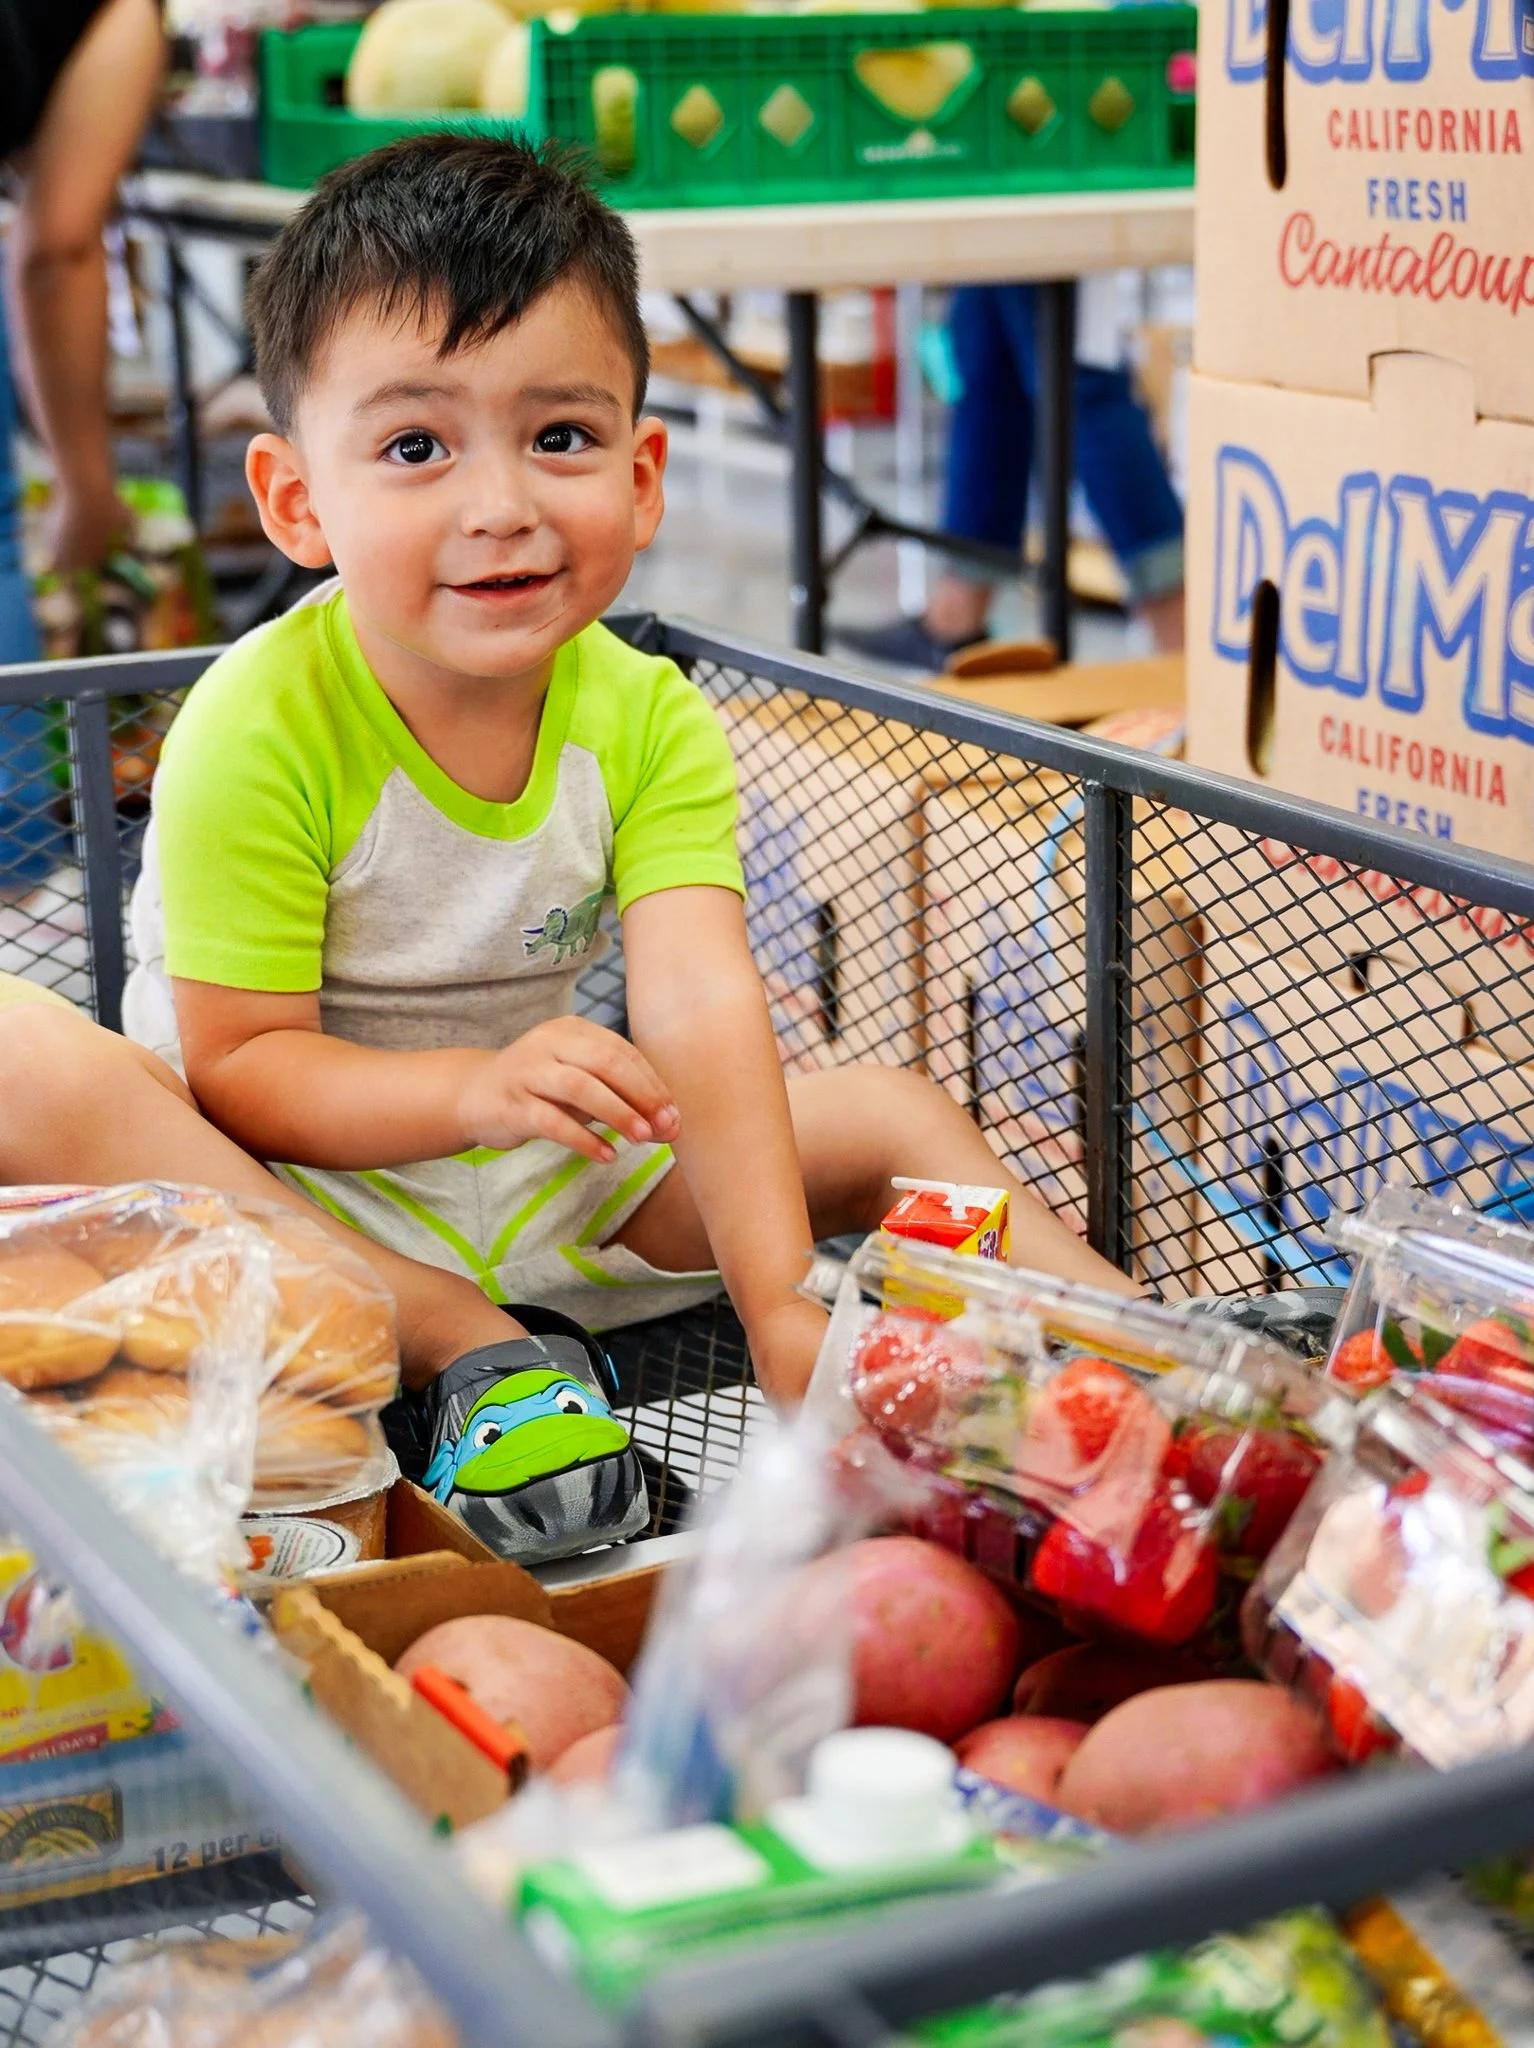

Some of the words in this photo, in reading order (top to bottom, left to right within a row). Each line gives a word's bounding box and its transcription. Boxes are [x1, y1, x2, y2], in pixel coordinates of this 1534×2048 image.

[1326, 109, 1523, 154] CALIFORNIA
[1367, 178, 1469, 222] FRESH
[1318, 714, 1509, 808] CALIFORNIA
[1357, 787, 1454, 841] FRESH
[153, 1841, 189, 1872] 12
[201, 1833, 248, 1867] per
